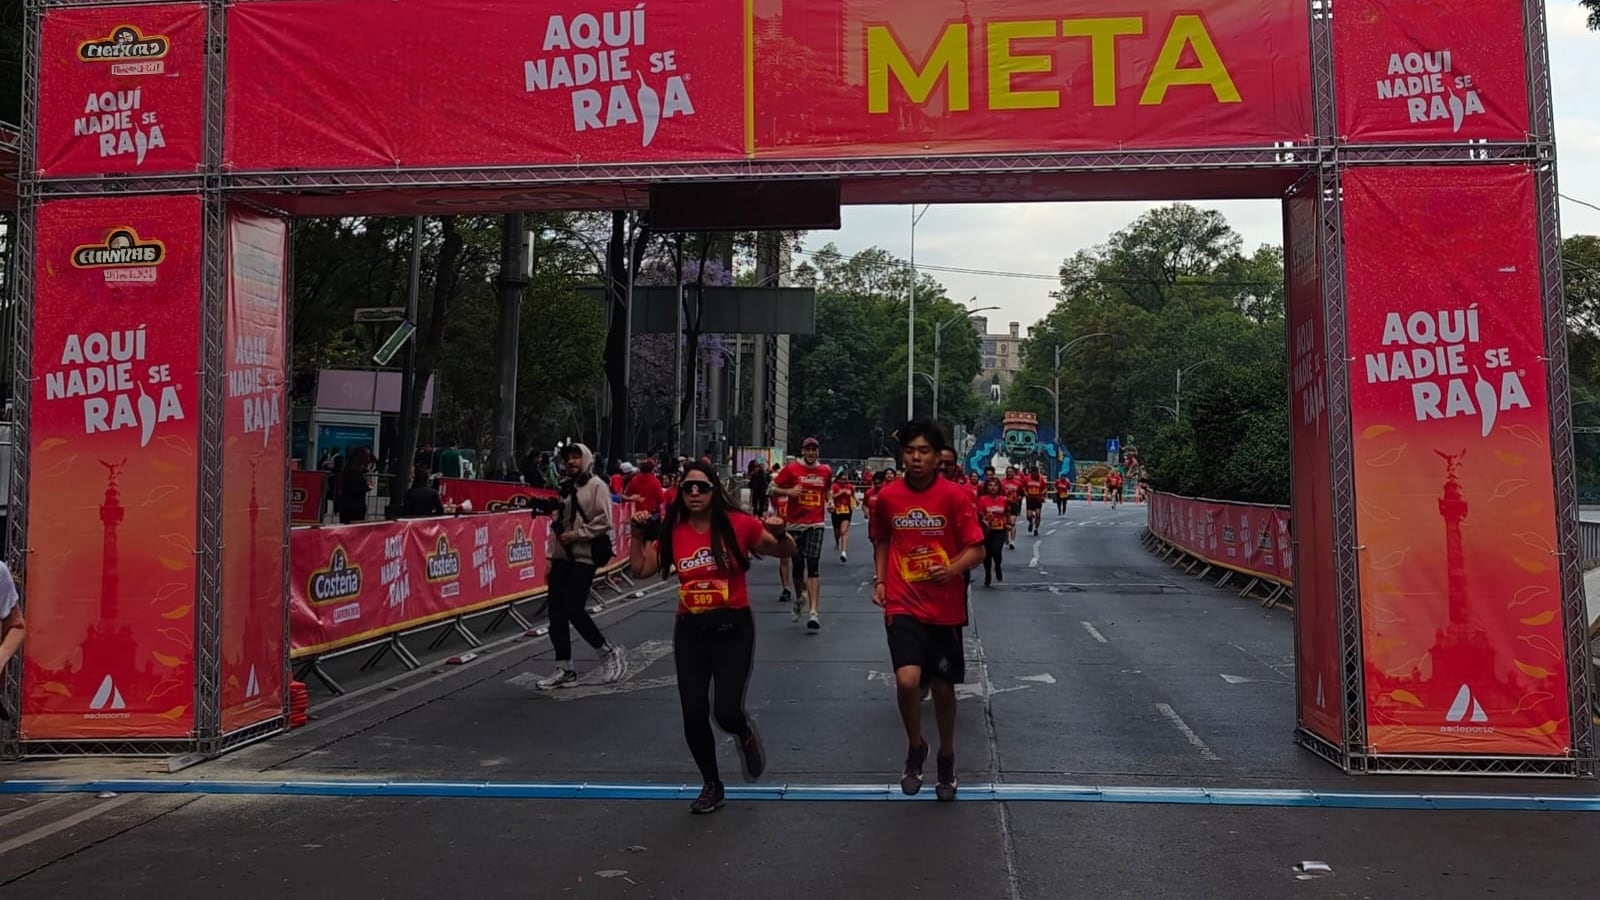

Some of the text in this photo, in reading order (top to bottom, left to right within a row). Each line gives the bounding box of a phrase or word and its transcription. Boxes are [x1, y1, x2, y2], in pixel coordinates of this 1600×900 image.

[542, 3, 646, 51] AQUÍ
[524, 48, 677, 92] NADIE SE
[866, 14, 1242, 114] META
[1387, 48, 1452, 75] AQUÍ
[85, 86, 142, 113] AQUÍ
[1376, 73, 1473, 99] NADIE SE
[74, 111, 157, 136] NADIE SE
[1381, 303, 1480, 346] AQUÍ
[61, 323, 147, 365] AQUÍ
[1365, 344, 1512, 384] NADIE SE
[46, 362, 171, 400] NADIE SE
[229, 367, 263, 398] NADIE
[334, 554, 344, 571] La
[440, 541, 447, 556] La
[697, 549, 709, 558] La
[429, 553, 458, 578] Costeña
[315, 570, 358, 599] Costeña
